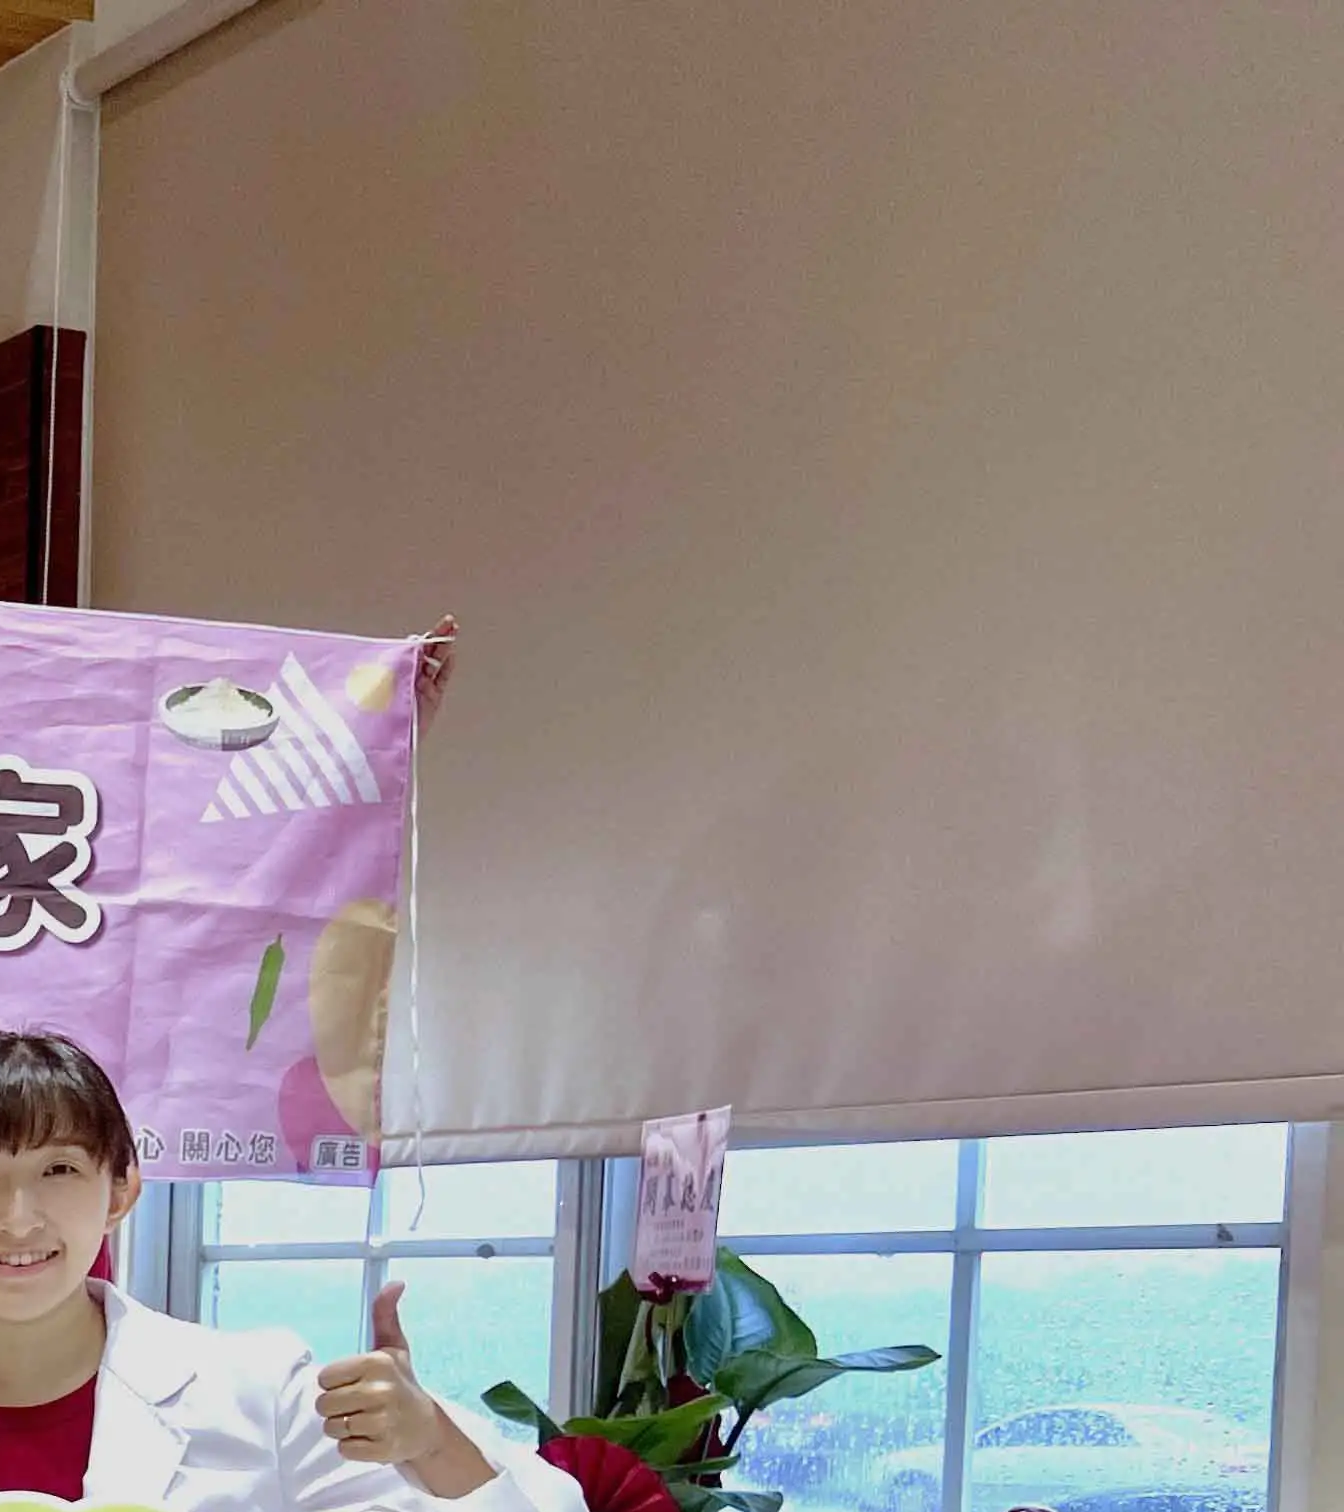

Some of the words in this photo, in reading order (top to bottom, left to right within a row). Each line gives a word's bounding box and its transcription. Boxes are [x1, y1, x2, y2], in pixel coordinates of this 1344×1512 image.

[181, 1130, 274, 1163] 關心您
[316, 1141, 362, 1167] 廣告
